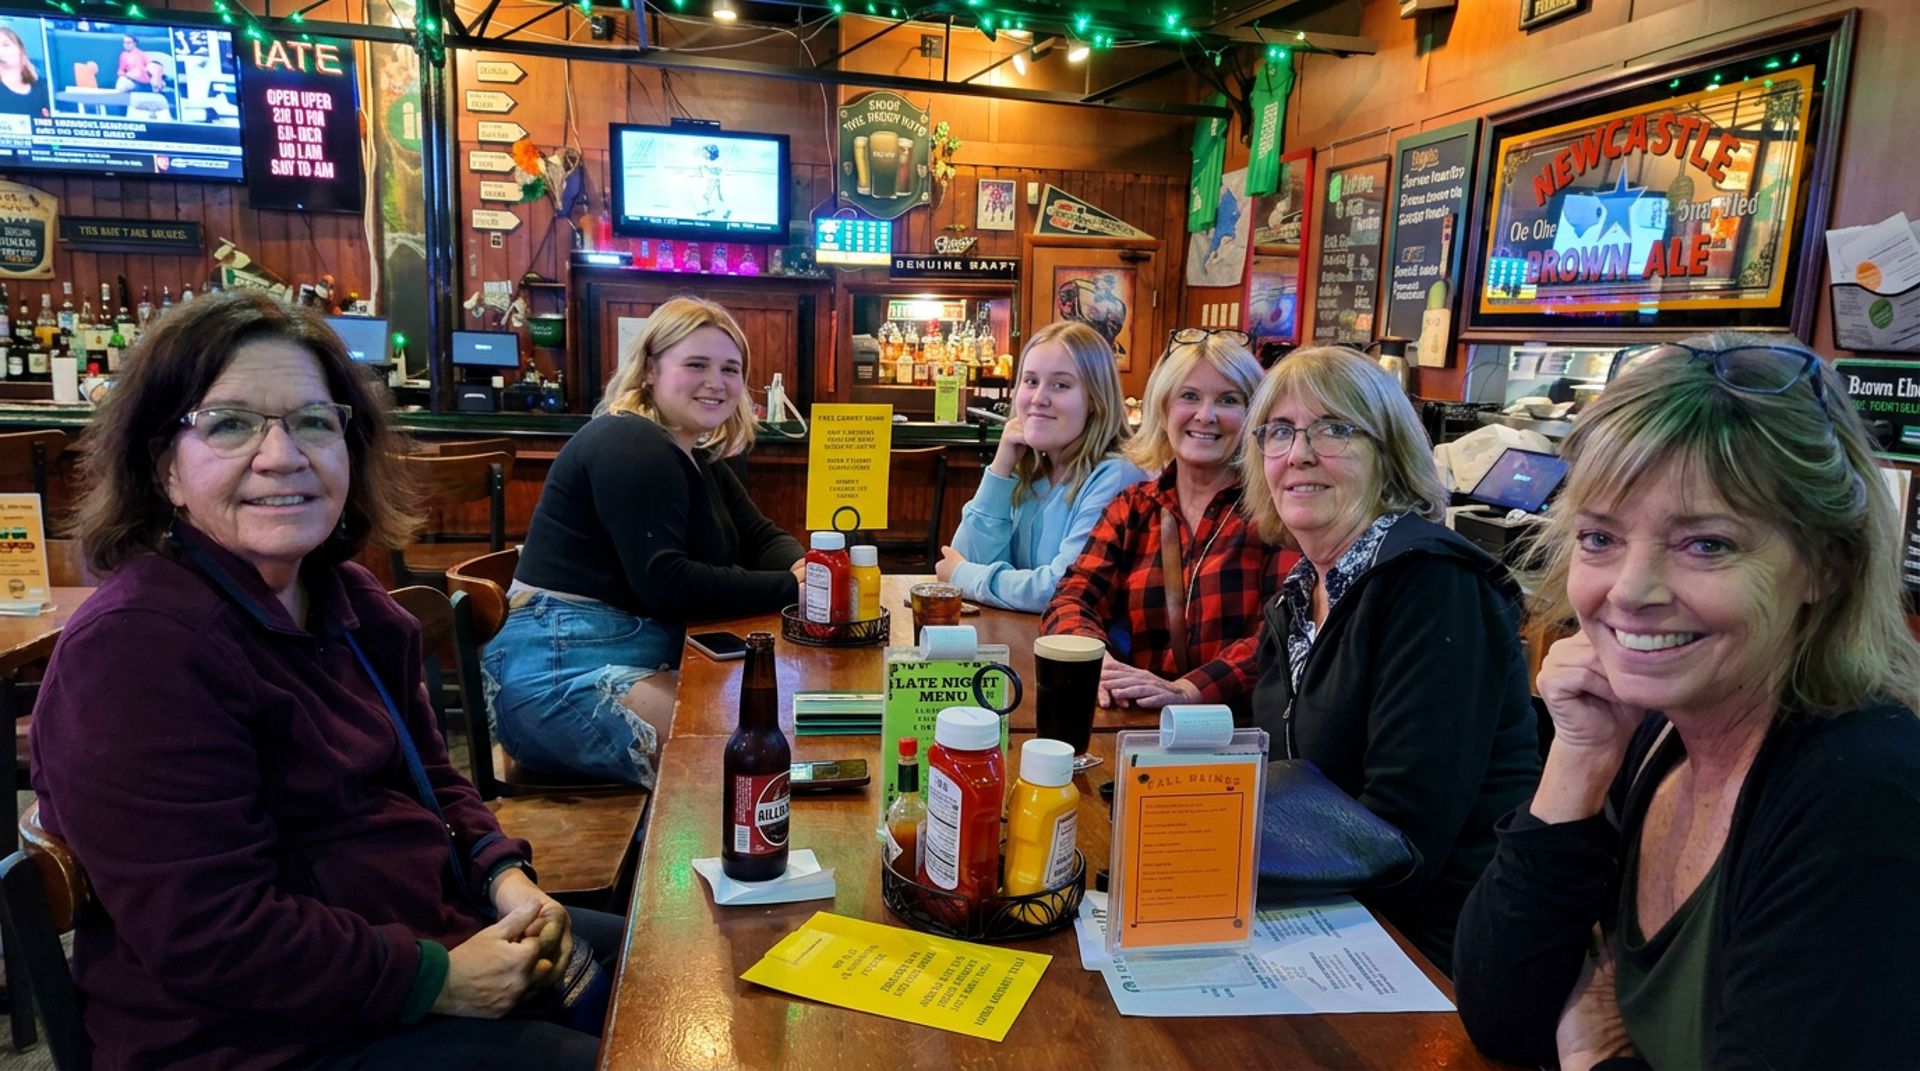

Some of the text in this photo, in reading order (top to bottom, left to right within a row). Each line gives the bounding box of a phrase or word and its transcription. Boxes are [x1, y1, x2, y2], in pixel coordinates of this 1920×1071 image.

[1532, 112, 1740, 207] NEWCASTLE
[1527, 233, 1711, 284] BROWN ALE
[896, 677, 937, 689] LATE
[919, 691, 968, 702] MENU
